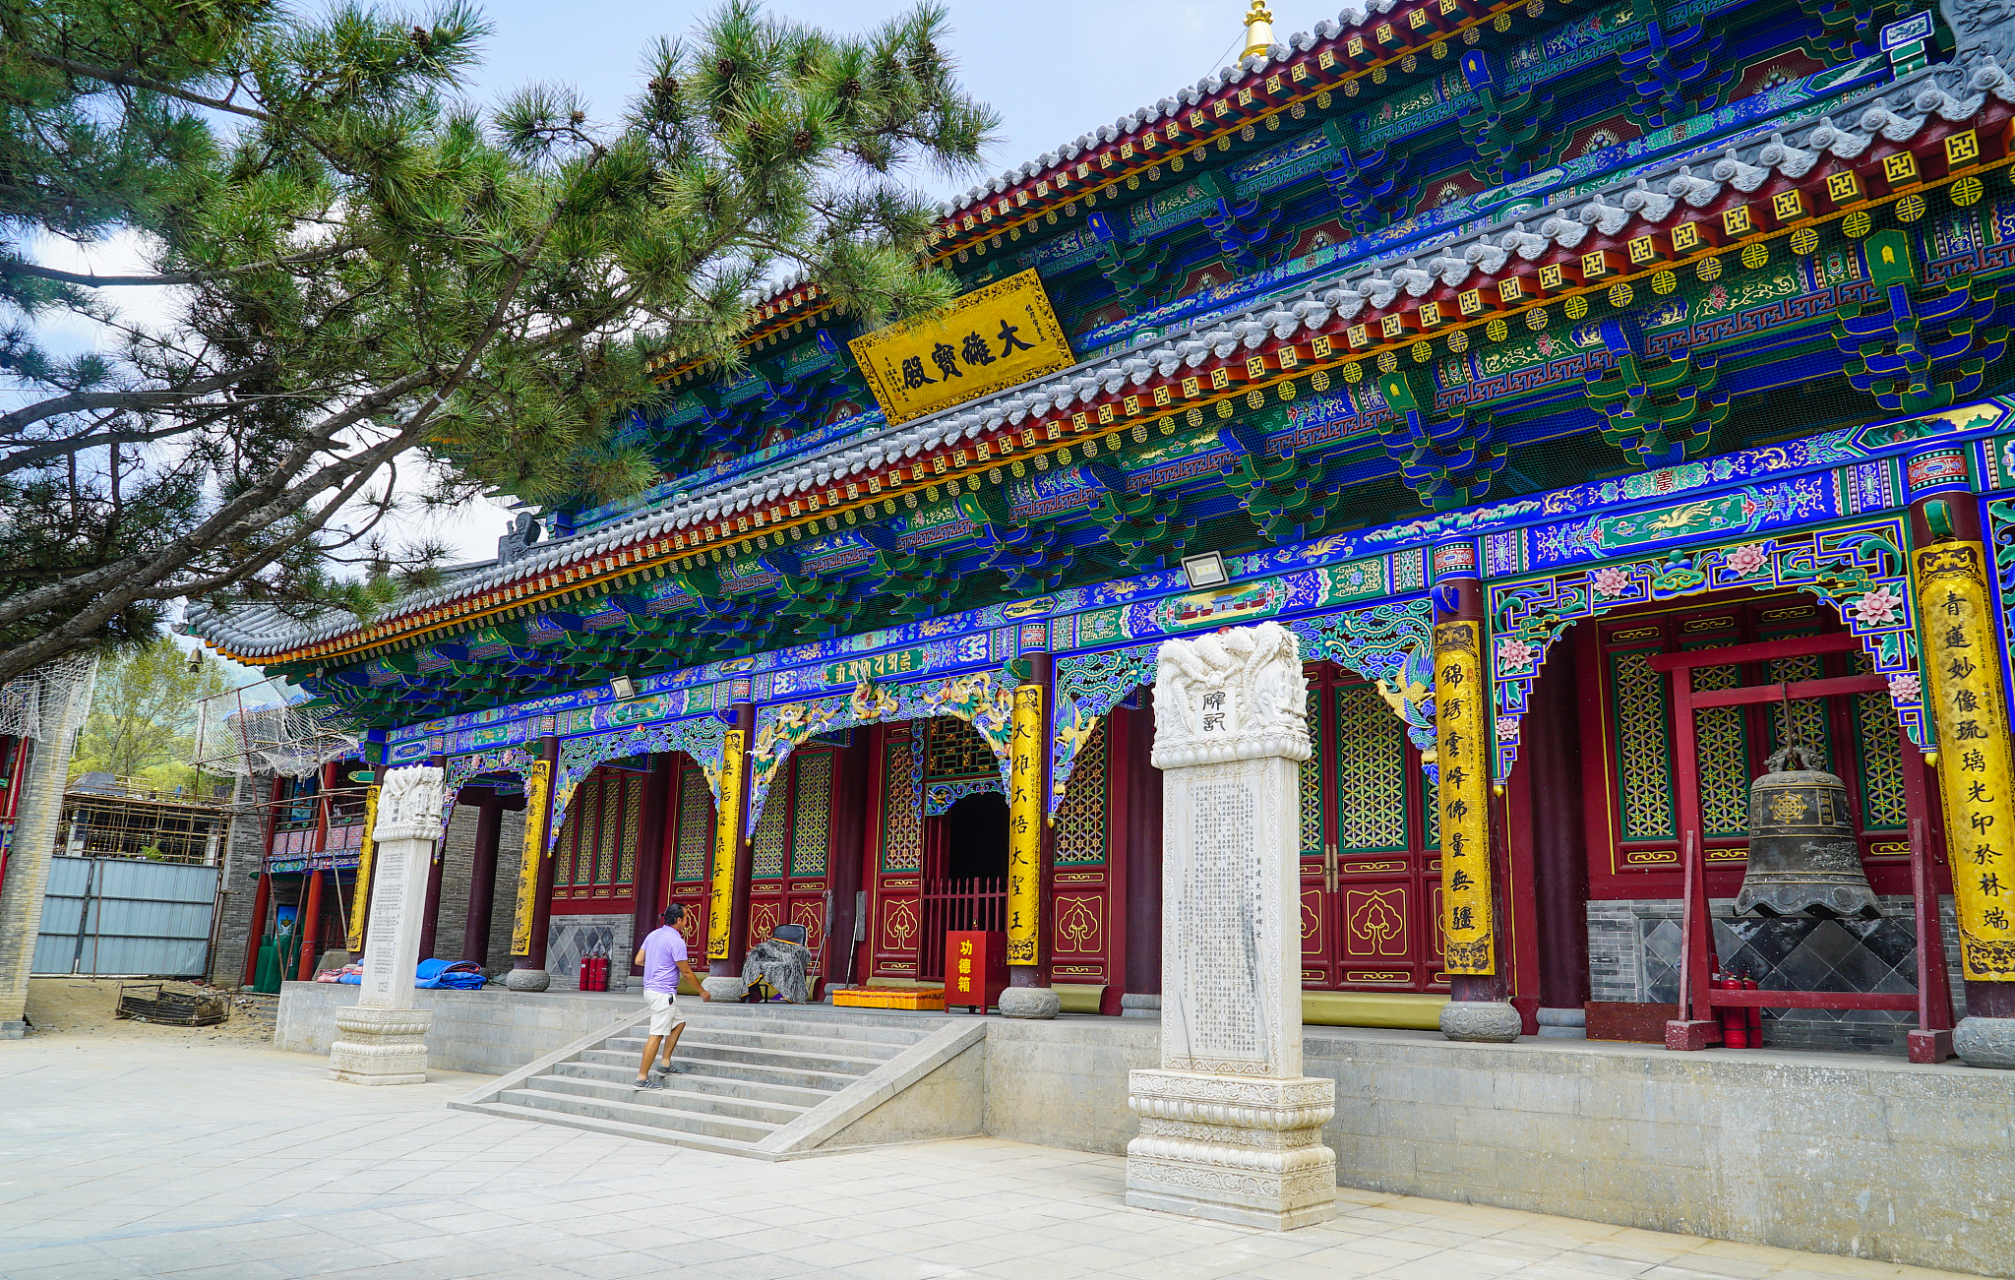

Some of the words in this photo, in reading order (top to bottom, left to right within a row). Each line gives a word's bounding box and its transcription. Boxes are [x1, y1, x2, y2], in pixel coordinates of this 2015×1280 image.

[902, 319, 1036, 390] 大雄寶殿
[1010, 720, 1031, 930] 大雄大悟大聖王
[957, 939, 973, 993] 功德箱
